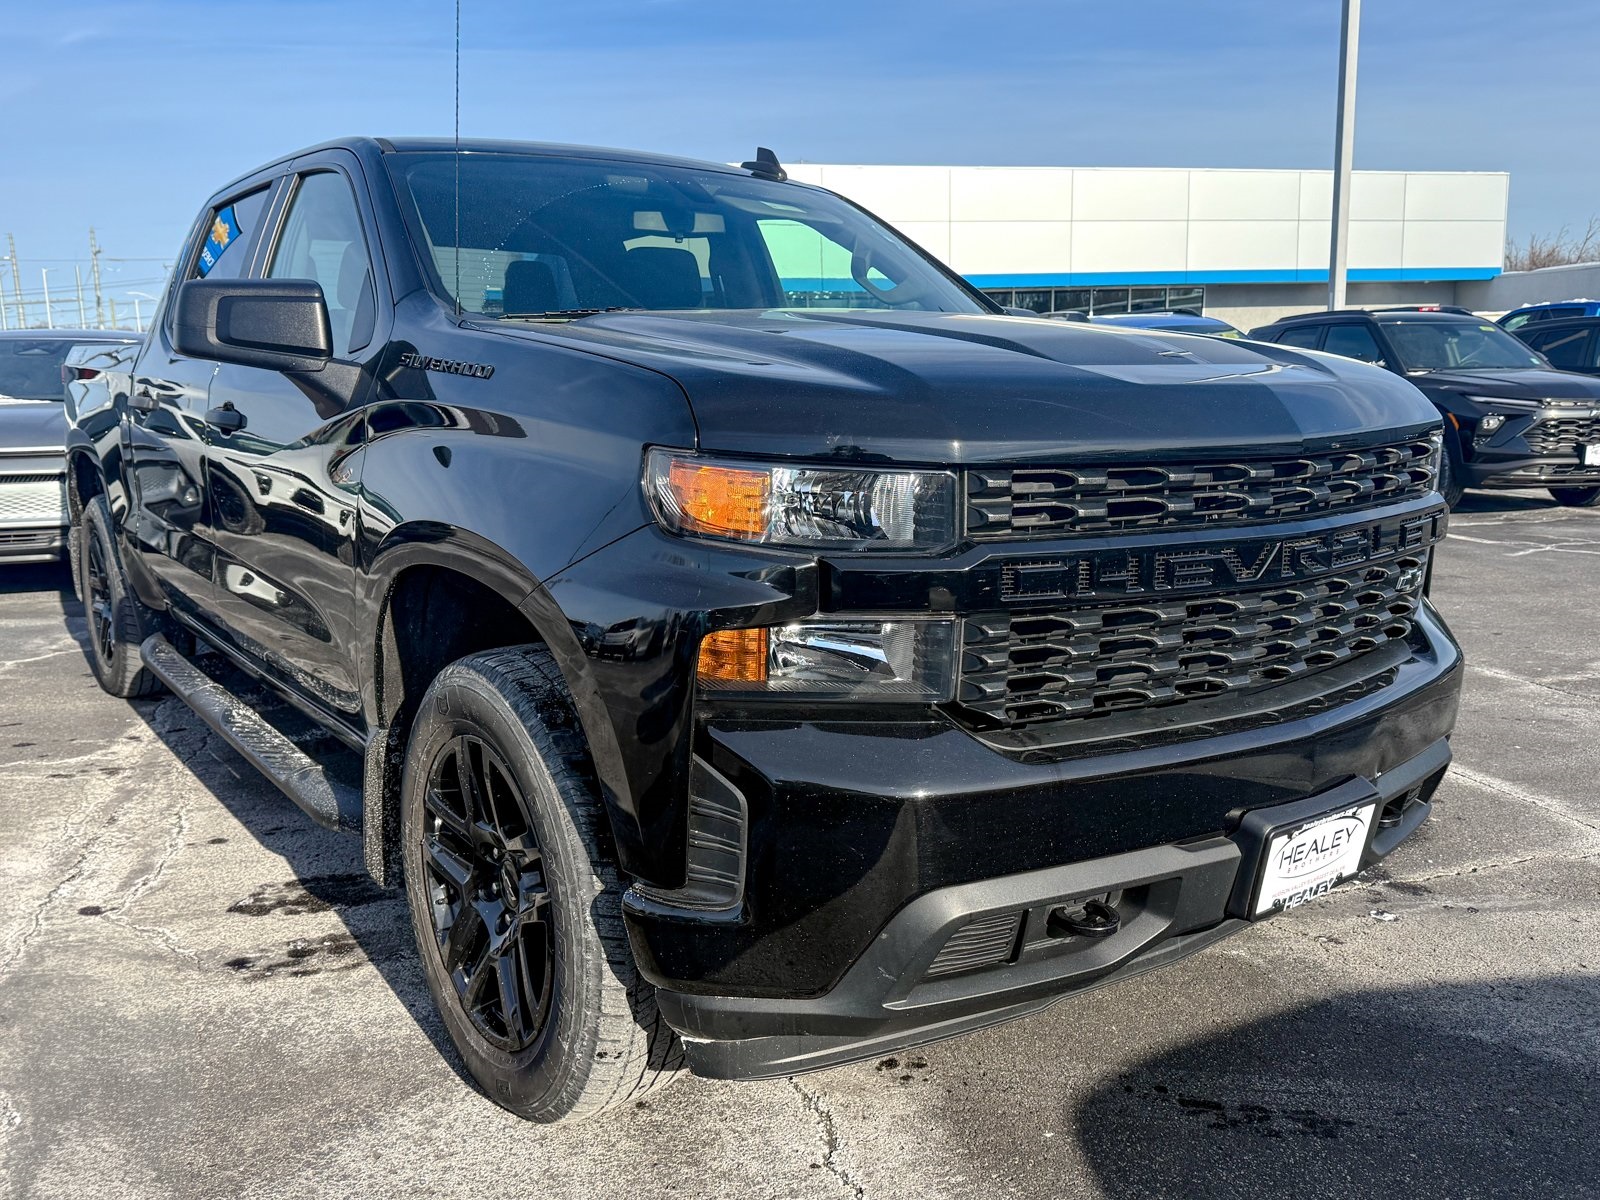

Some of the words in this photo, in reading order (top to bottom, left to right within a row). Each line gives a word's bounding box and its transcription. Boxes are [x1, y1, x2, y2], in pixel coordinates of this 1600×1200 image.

[1000, 511, 1444, 601] CHEVROLET
[1279, 824, 1359, 870] HEALEY
[1284, 877, 1337, 911] HEALEY
